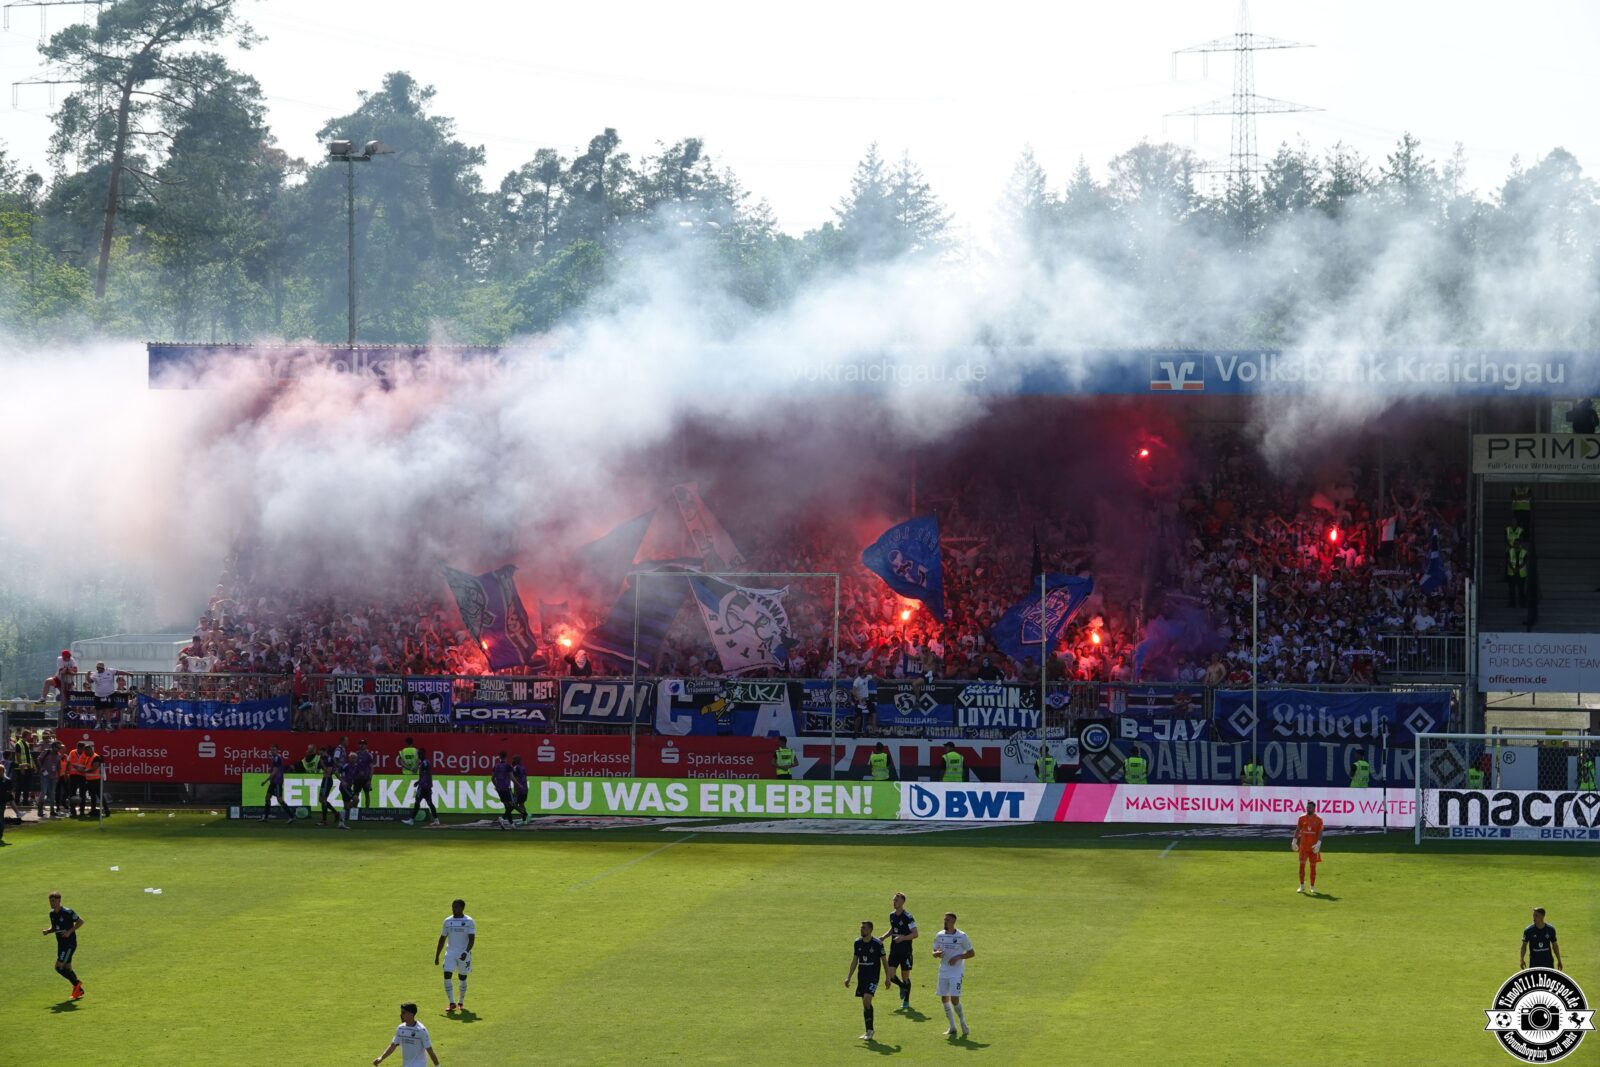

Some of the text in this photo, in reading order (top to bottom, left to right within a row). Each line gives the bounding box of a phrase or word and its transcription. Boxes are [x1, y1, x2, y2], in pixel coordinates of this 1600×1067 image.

[1215, 353, 1566, 390] Volksbank Kraichgau
[1489, 656, 1510, 668] FÜR
[1512, 658, 1533, 668] DAS
[1535, 658, 1571, 668] GANZE
[337, 678, 403, 693] DAUER STEHER
[1488, 674, 1548, 684] officemix.de
[407, 681, 450, 693] BIERIGE
[897, 684, 936, 692] HAMURG
[562, 682, 648, 718] CDN
[407, 713, 451, 724] BANDITEN
[455, 708, 546, 721] FORZA
[895, 717, 938, 725] HOOLIGANS
[958, 707, 1041, 728] LOYALTY
[1272, 703, 1390, 739] Lübeck
[1120, 718, 1207, 741] B-JAY
[102, 745, 168, 759] Sparkasse
[563, 750, 630, 766] Sparkasse
[687, 752, 754, 767] Sparkasse
[1263, 741, 1309, 780] ON
[1319, 741, 1416, 781] TOUR
[103, 762, 174, 778] Heidelberg
[378, 779, 529, 810] KANNS
[540, 781, 592, 811] DU
[602, 782, 689, 812] WAS
[700, 783, 873, 815] ERLEBEN!
[945, 790, 1025, 819] BWT
[1125, 796, 1235, 812] MAGNESIUM
[1239, 797, 1355, 814] MINERAIZED
[1452, 828, 1498, 838] BENZ
[1540, 828, 1587, 839] BENZ
